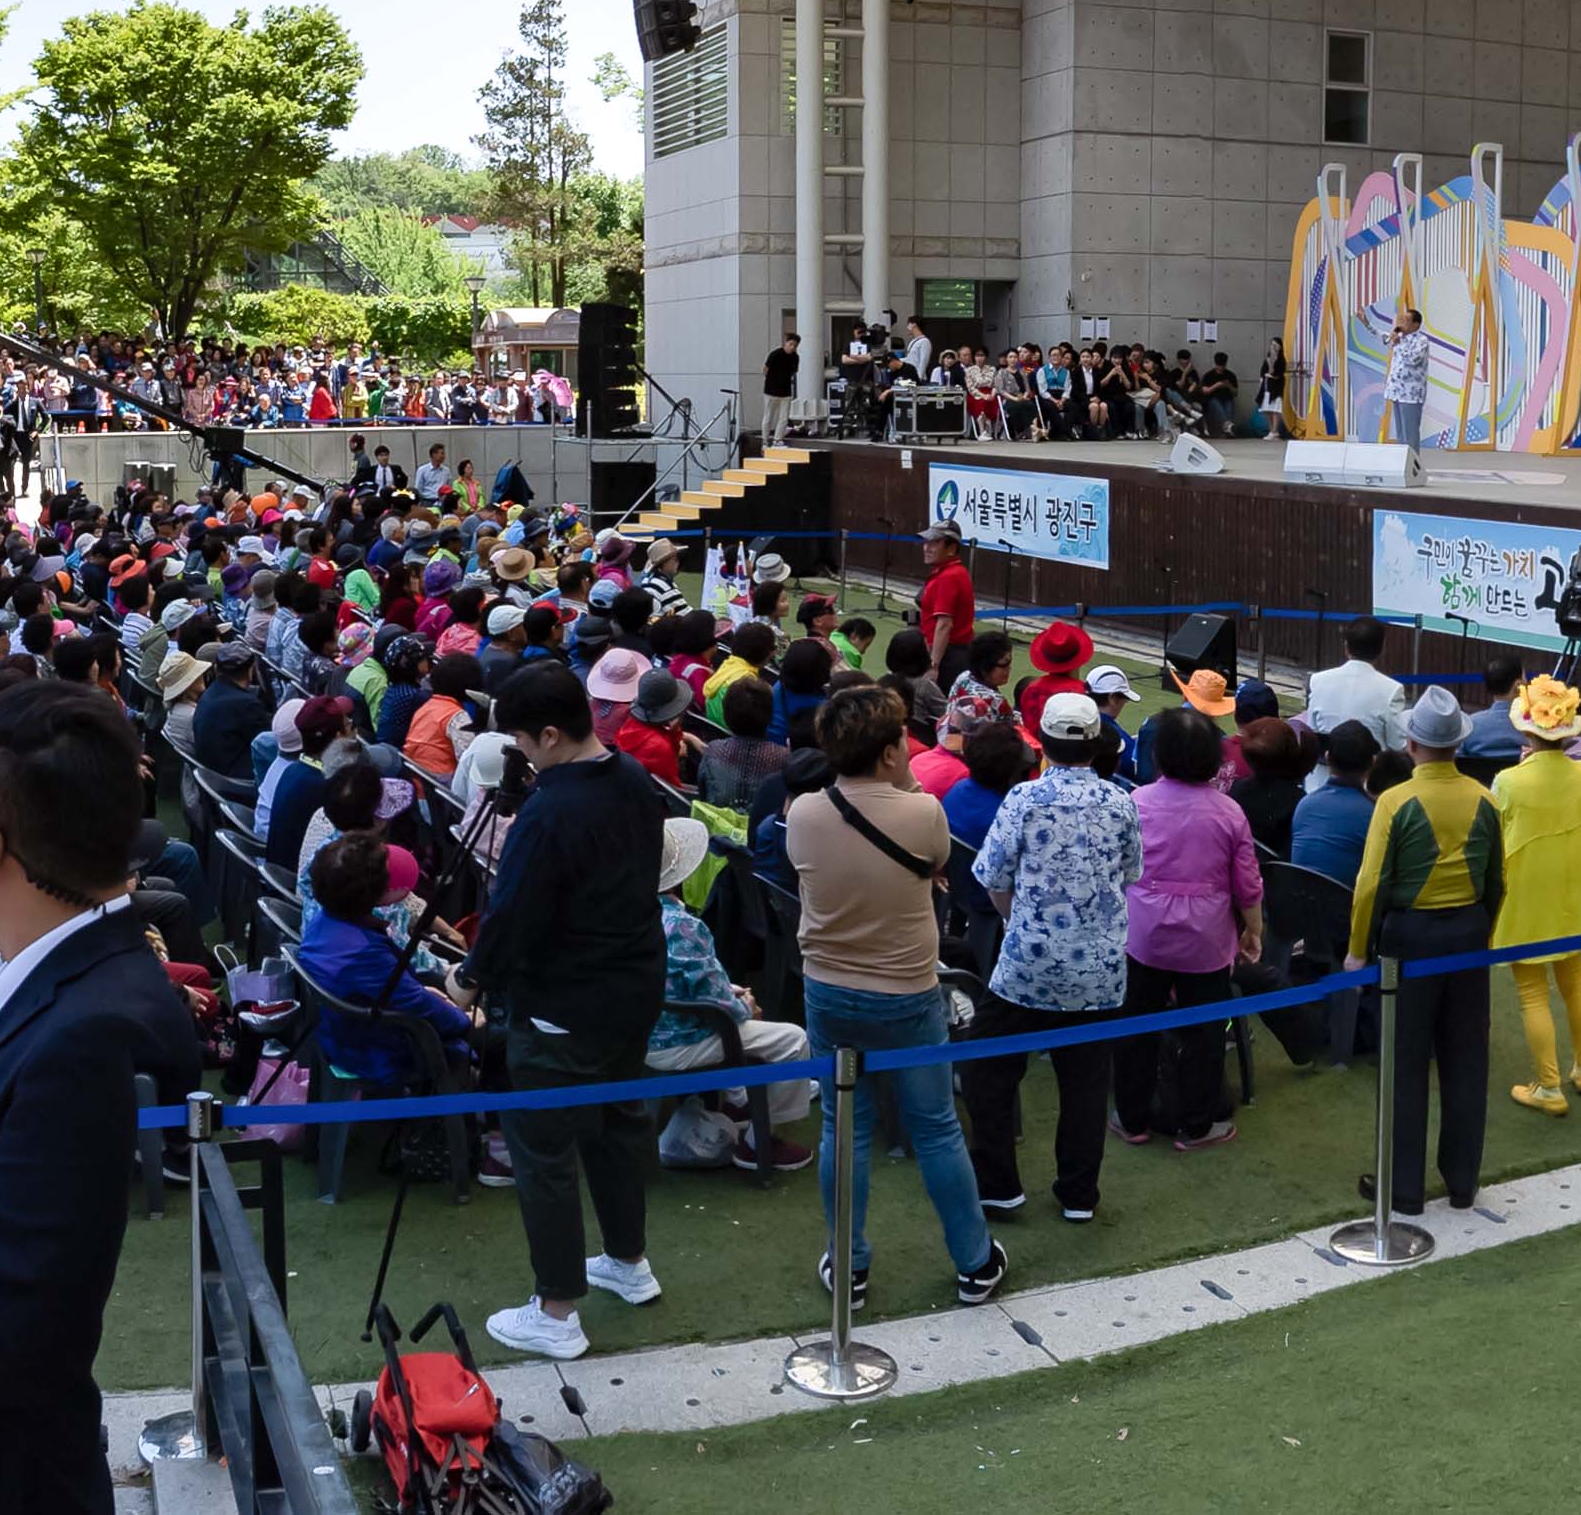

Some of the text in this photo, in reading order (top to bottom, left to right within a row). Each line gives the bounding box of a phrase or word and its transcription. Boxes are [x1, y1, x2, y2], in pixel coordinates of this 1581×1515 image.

[963, 487, 1097, 542] 서울특별시 광진구
[1417, 534, 1535, 581] 구민이 꿈꾸는 가치
[1440, 573, 1528, 617] 함께 만드는
